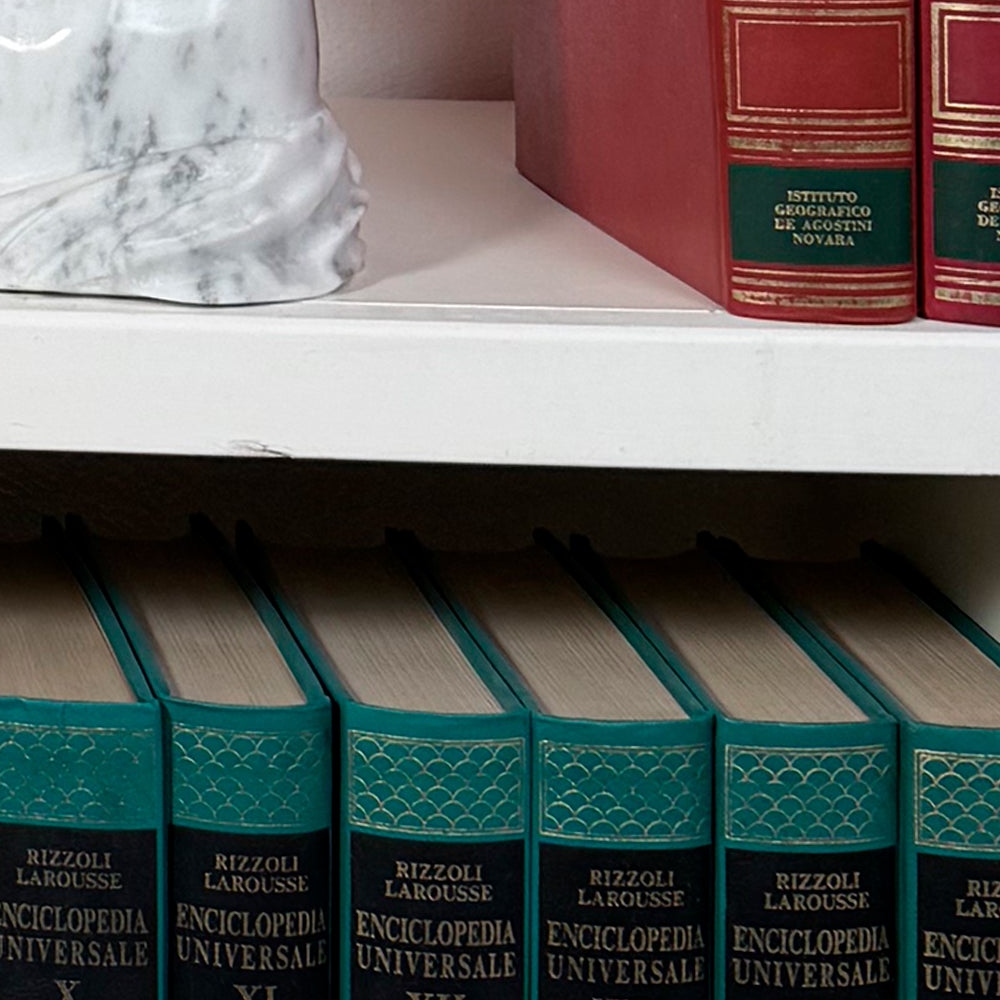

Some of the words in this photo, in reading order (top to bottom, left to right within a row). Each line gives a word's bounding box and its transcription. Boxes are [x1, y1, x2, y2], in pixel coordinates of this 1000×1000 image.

[787, 190, 858, 203] ISTITUTO
[775, 204, 872, 217] GEOGRAFICO
[802, 220, 872, 231] AGOSTINI
[793, 233, 855, 246] NOVARA
[27, 849, 111, 869] RIZZOLI
[215, 854, 299, 873] RIZZOLI
[16, 868, 123, 890] LAROUSSE
[396, 861, 482, 882] RIZZOLI
[590, 869, 674, 888] RIZZOLI
[776, 872, 860, 890] RIZZOLI
[204, 873, 309, 893] LAROUSSE
[385, 880, 493, 902] LAROUSSE
[578, 889, 685, 908] LAROUSSE
[764, 892, 870, 911] LAROUSSE
[956, 898, 1000, 918] LAR
[176, 903, 326, 937] ENCICLOPEDIA
[356, 910, 516, 946] ENCICLOPEDIA
[547, 920, 704, 952] ENCICLOPEDIA
[732, 925, 889, 955] ENCICLOPEDIA
[176, 937, 327, 971] UNIVERSALE
[357, 944, 516, 979] UNIVERSALE
[547, 953, 704, 984] UNIVERSALE
[732, 957, 890, 988] UNIVERSALE
